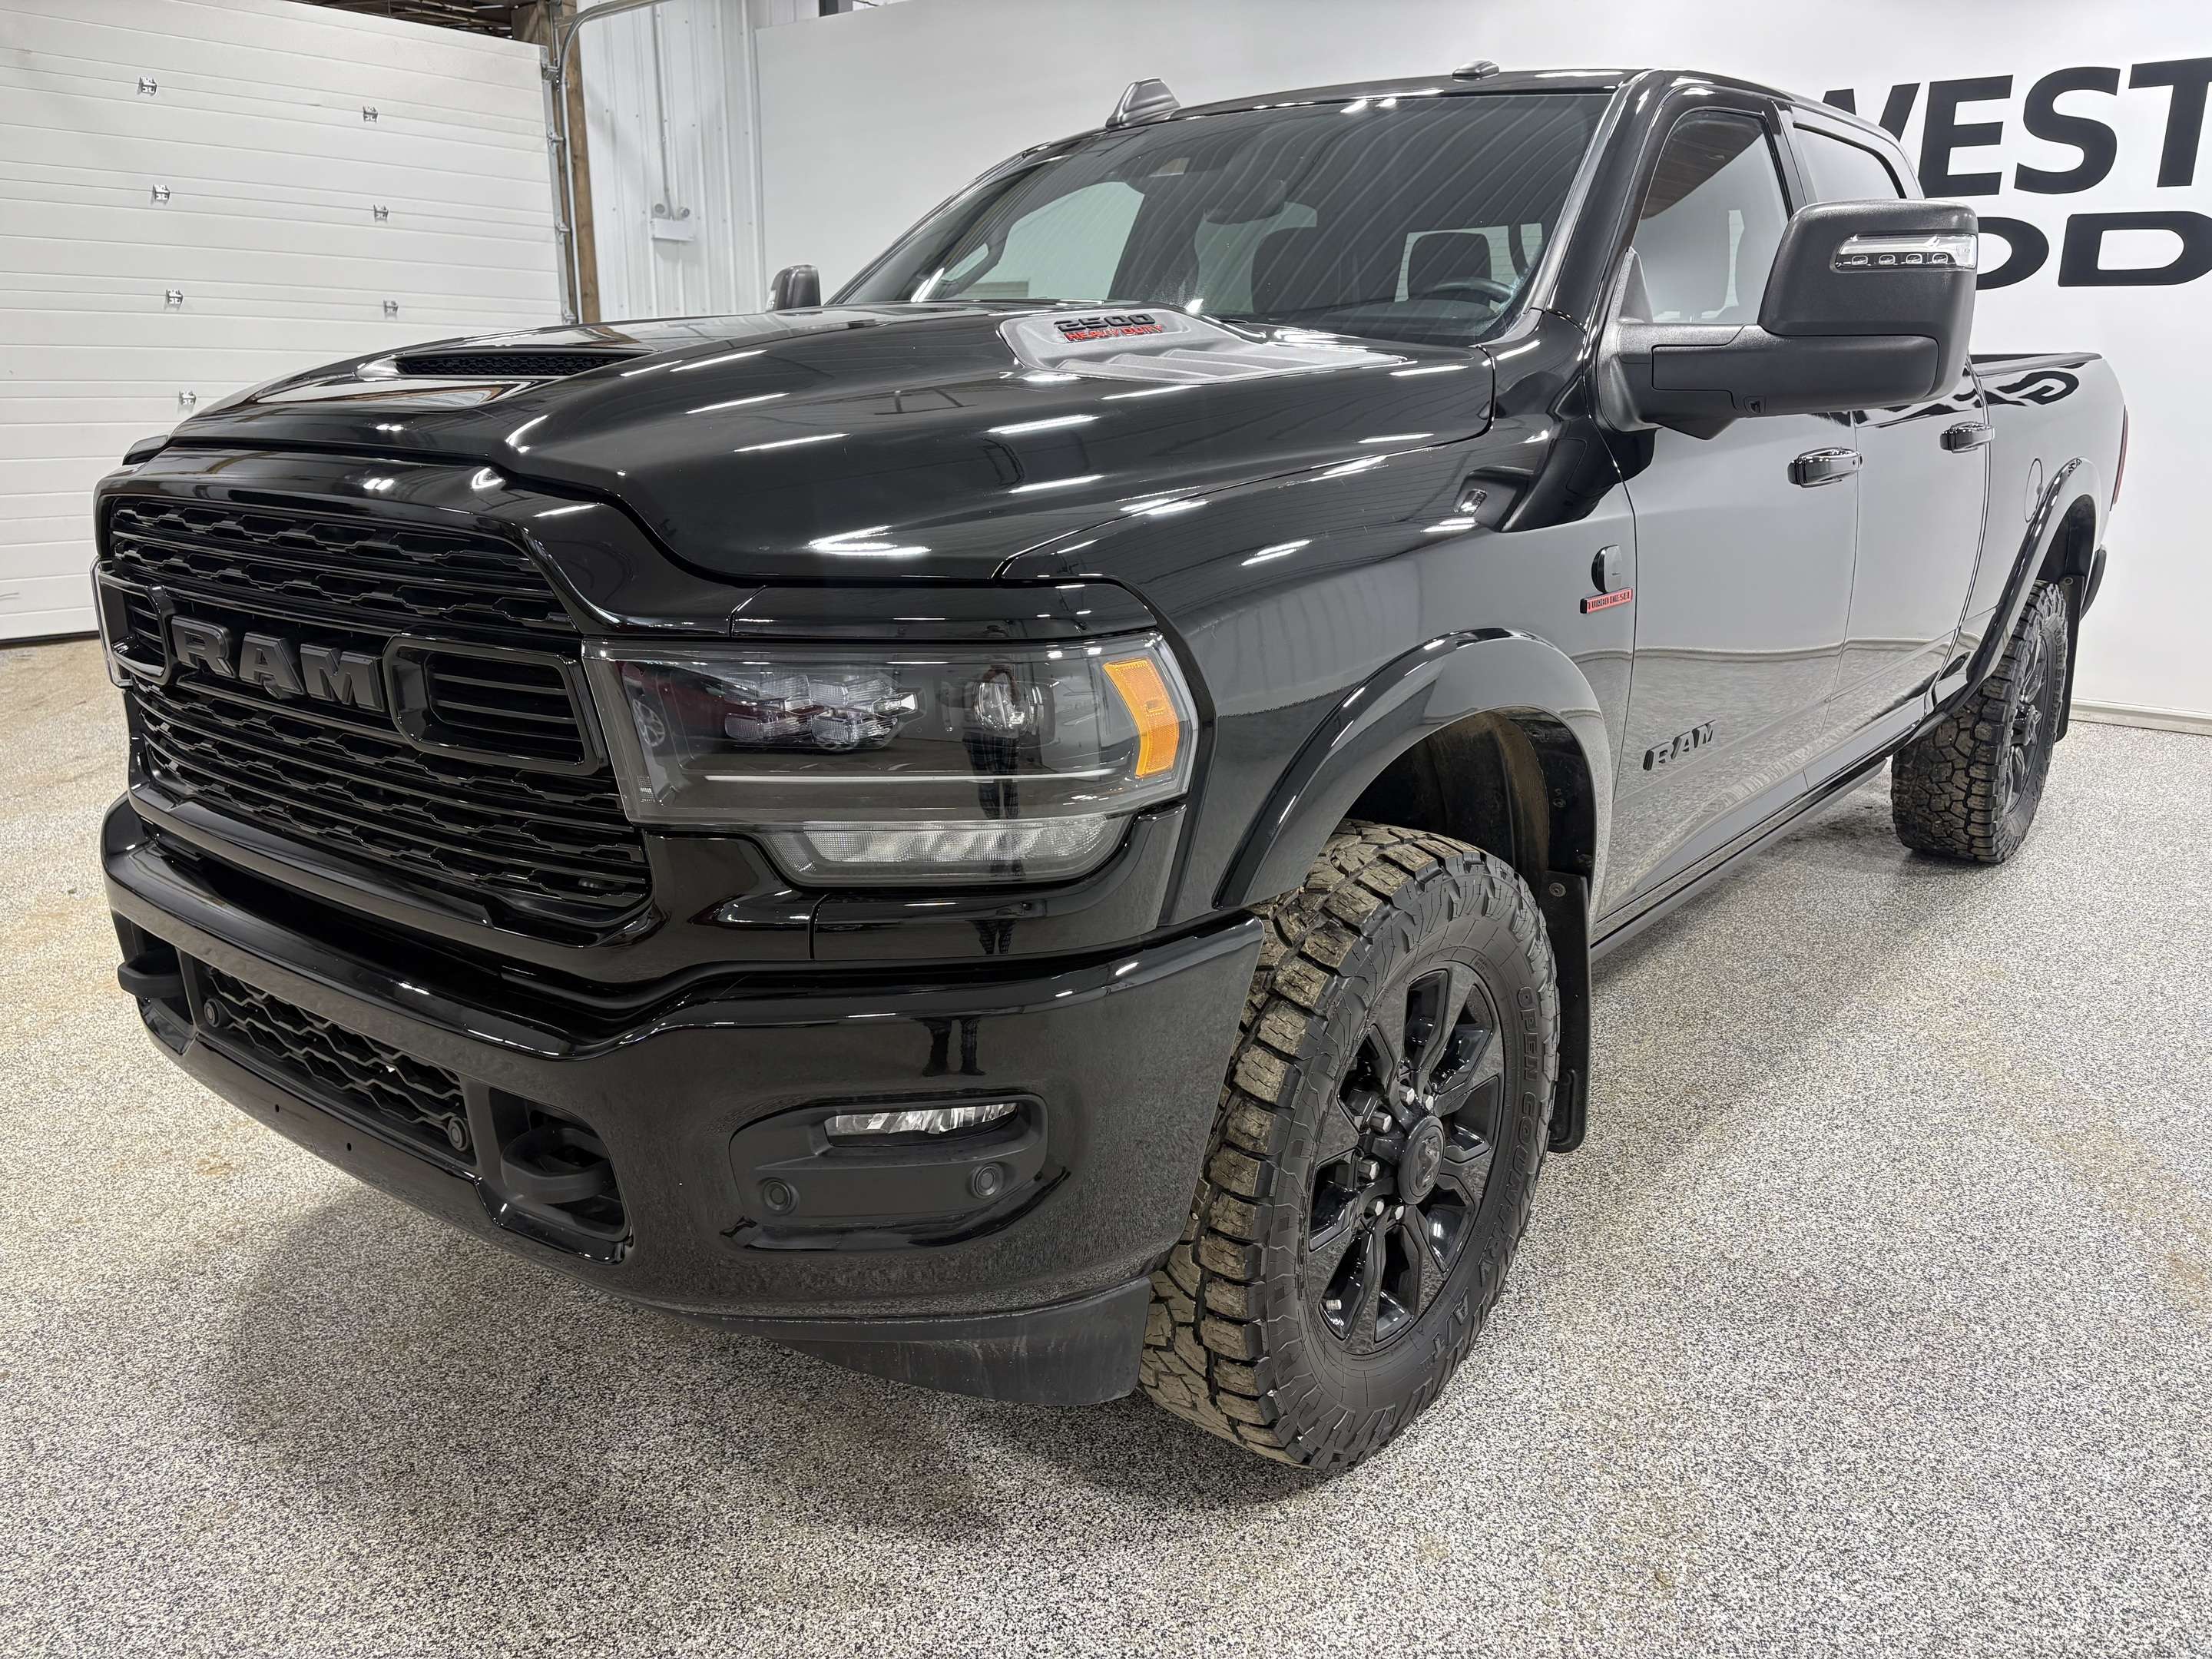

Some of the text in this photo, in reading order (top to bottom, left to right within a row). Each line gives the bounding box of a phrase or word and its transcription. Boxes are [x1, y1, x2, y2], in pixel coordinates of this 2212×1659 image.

[1054, 313, 1155, 332] 2500
[1064, 324, 1163, 342] HEAVY DUTY
[1588, 591, 1630, 610] TURBO DIESEL
[171, 615, 385, 711] RAM
[1643, 720, 1716, 770] RAM
[1517, 986, 1538, 1081] OPEN
[1478, 1091, 1537, 1288] COUNTRY
